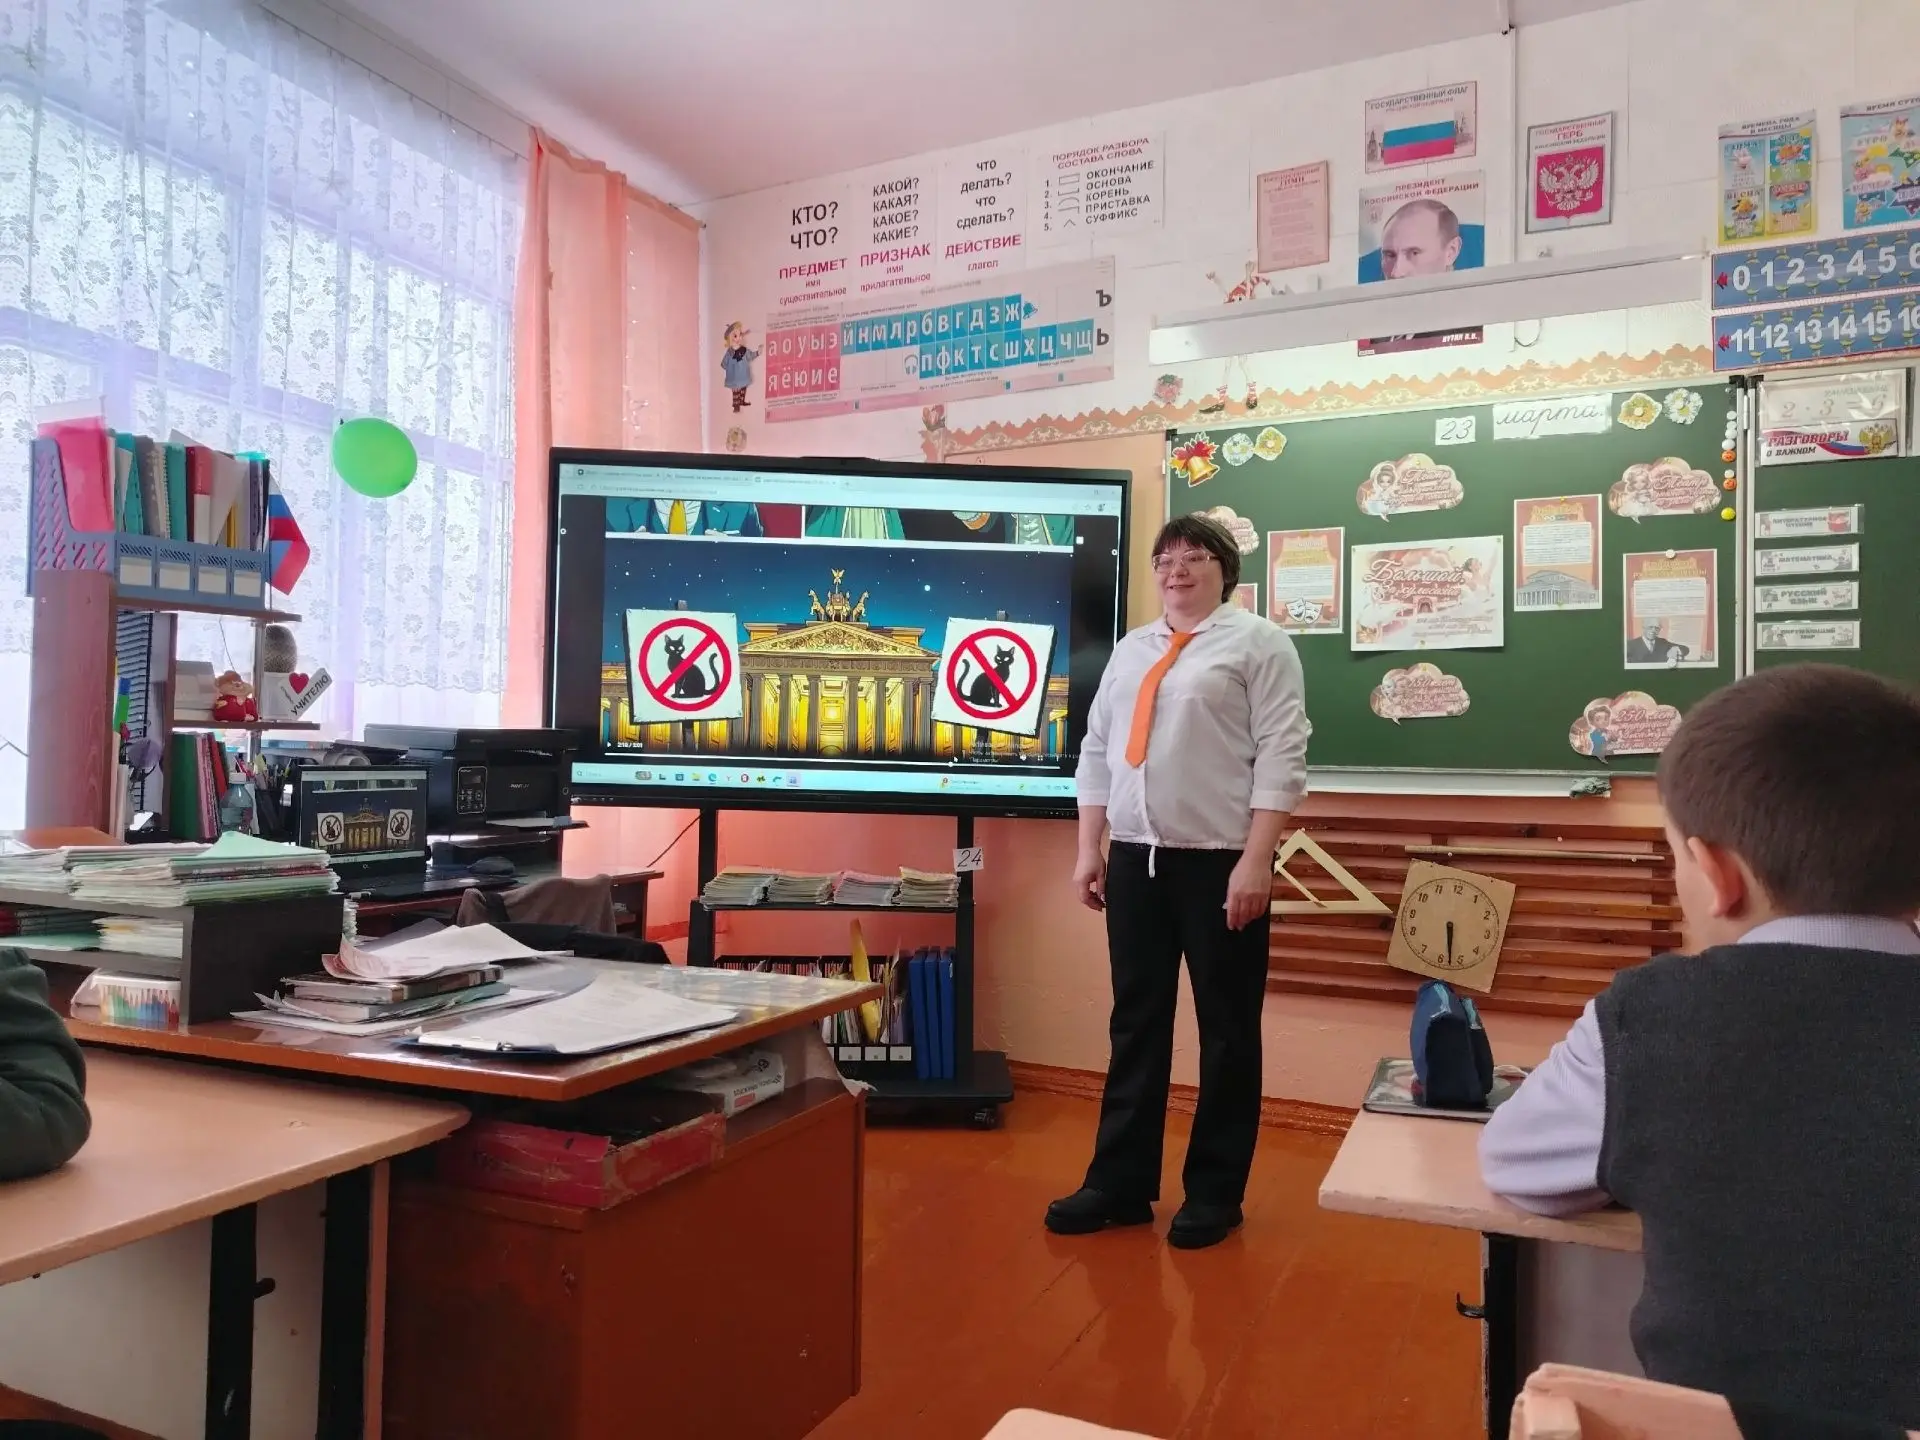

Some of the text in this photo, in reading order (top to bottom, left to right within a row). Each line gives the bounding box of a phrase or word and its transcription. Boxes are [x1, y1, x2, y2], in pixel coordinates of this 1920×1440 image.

[1052, 137, 1149, 162] ПОРЯДОК РАЗБОРА
[1058, 147, 1143, 169] СОСТАВА СЛОВА
[976, 159, 997, 172] что
[1086, 160, 1155, 180] ОКОНЧАНИЕ
[873, 177, 919, 197] КАКОЙ?
[960, 172, 1012, 194] делать?
[1086, 176, 1132, 190] ОСНОВА
[1395, 178, 1446, 192] ПРЕЗИДЕНТ
[1424, 183, 1479, 196] ФЕДЕРАЦИИ
[873, 193, 919, 213] КАКАЯ?
[976, 195, 996, 208] что
[1086, 187, 1130, 202] КОРЕНЬ
[1085, 194, 1150, 213] ПРИСТАВКА
[792, 201, 838, 226] КТО?
[873, 209, 919, 228] КАКОЕ?
[956, 208, 1015, 230] сделать?
[1086, 208, 1138, 225] СУФФИКС
[790, 226, 838, 250] ЧТО?
[873, 225, 919, 244] КАКИЕ?
[860, 243, 931, 267] ПРИЗНАК
[945, 234, 1022, 259] ДЕЙСТВИЕ
[779, 258, 848, 280] ПРЕДМЕТ
[967, 259, 998, 272] глагол
[1732, 265, 1750, 291] 0
[1760, 261, 1774, 287] 1
[1787, 257, 1806, 285] 2
[1817, 254, 1835, 281] 3
[1846, 249, 1866, 276] 4
[1878, 245, 1897, 274] 5
[860, 273, 931, 292] прилагательное
[779, 287, 847, 305] существительное
[1731, 305, 1920, 353] 11 12 13 14 15 16
[1440, 419, 1473, 440] 23
[1767, 430, 1850, 447] РАЗГОВОРЫ
[1775, 446, 1817, 457] ВАЖНОМ
[291, 674, 329, 715] УЧИТЕЛЮ
[957, 848, 982, 868] 24
[1418, 892, 1429, 903] 10
[1435, 884, 1443, 895] 11
[1453, 884, 1463, 895] 12
[1473, 894, 1478, 904] 1
[1409, 909, 1416, 919] 9
[1483, 910, 1491, 920] 2
[1409, 926, 1417, 936] 8
[1483, 930, 1491, 940] 3
[1421, 943, 1428, 954] 7
[1472, 945, 1480, 955] 4
[1437, 953, 1445, 963] 6
[1457, 954, 1464, 965] 5
